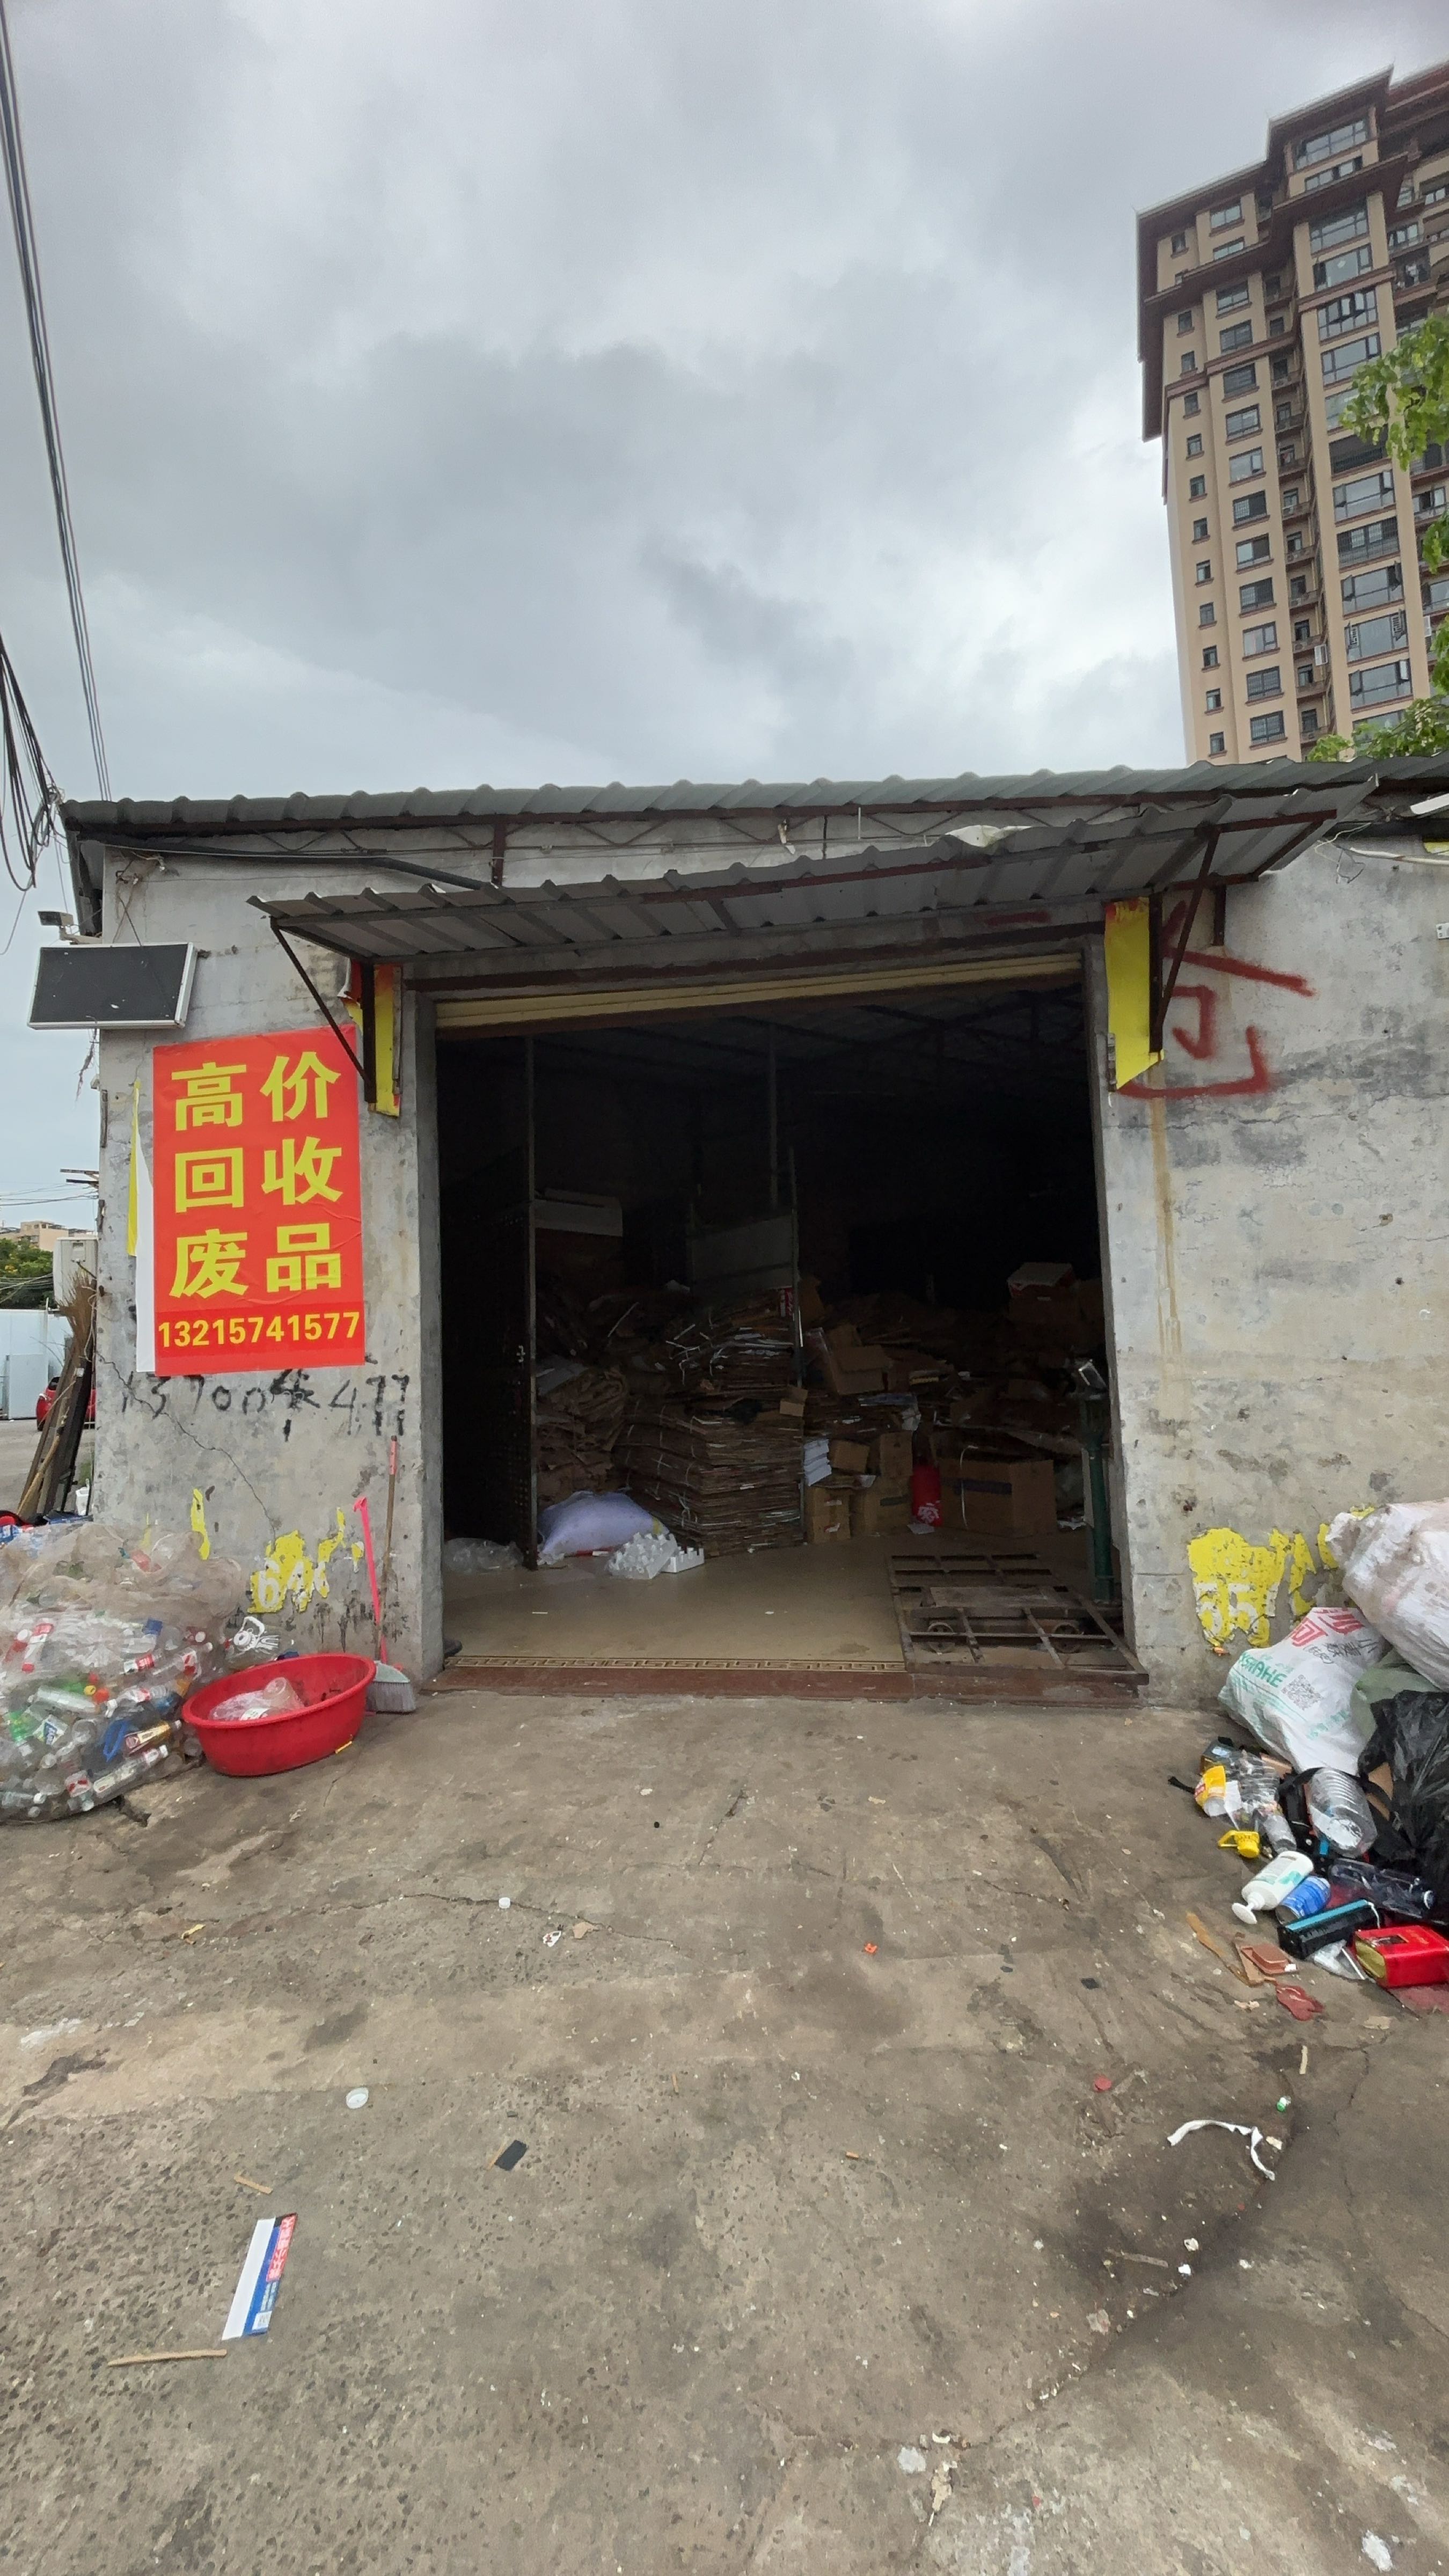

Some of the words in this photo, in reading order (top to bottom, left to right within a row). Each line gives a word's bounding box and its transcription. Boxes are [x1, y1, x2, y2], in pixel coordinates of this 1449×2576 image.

[171, 1050, 341, 1131] 高价
[175, 1136, 342, 1213] 回收
[169, 1223, 342, 1298] 废品
[158, 1312, 360, 1348] 13215741577
